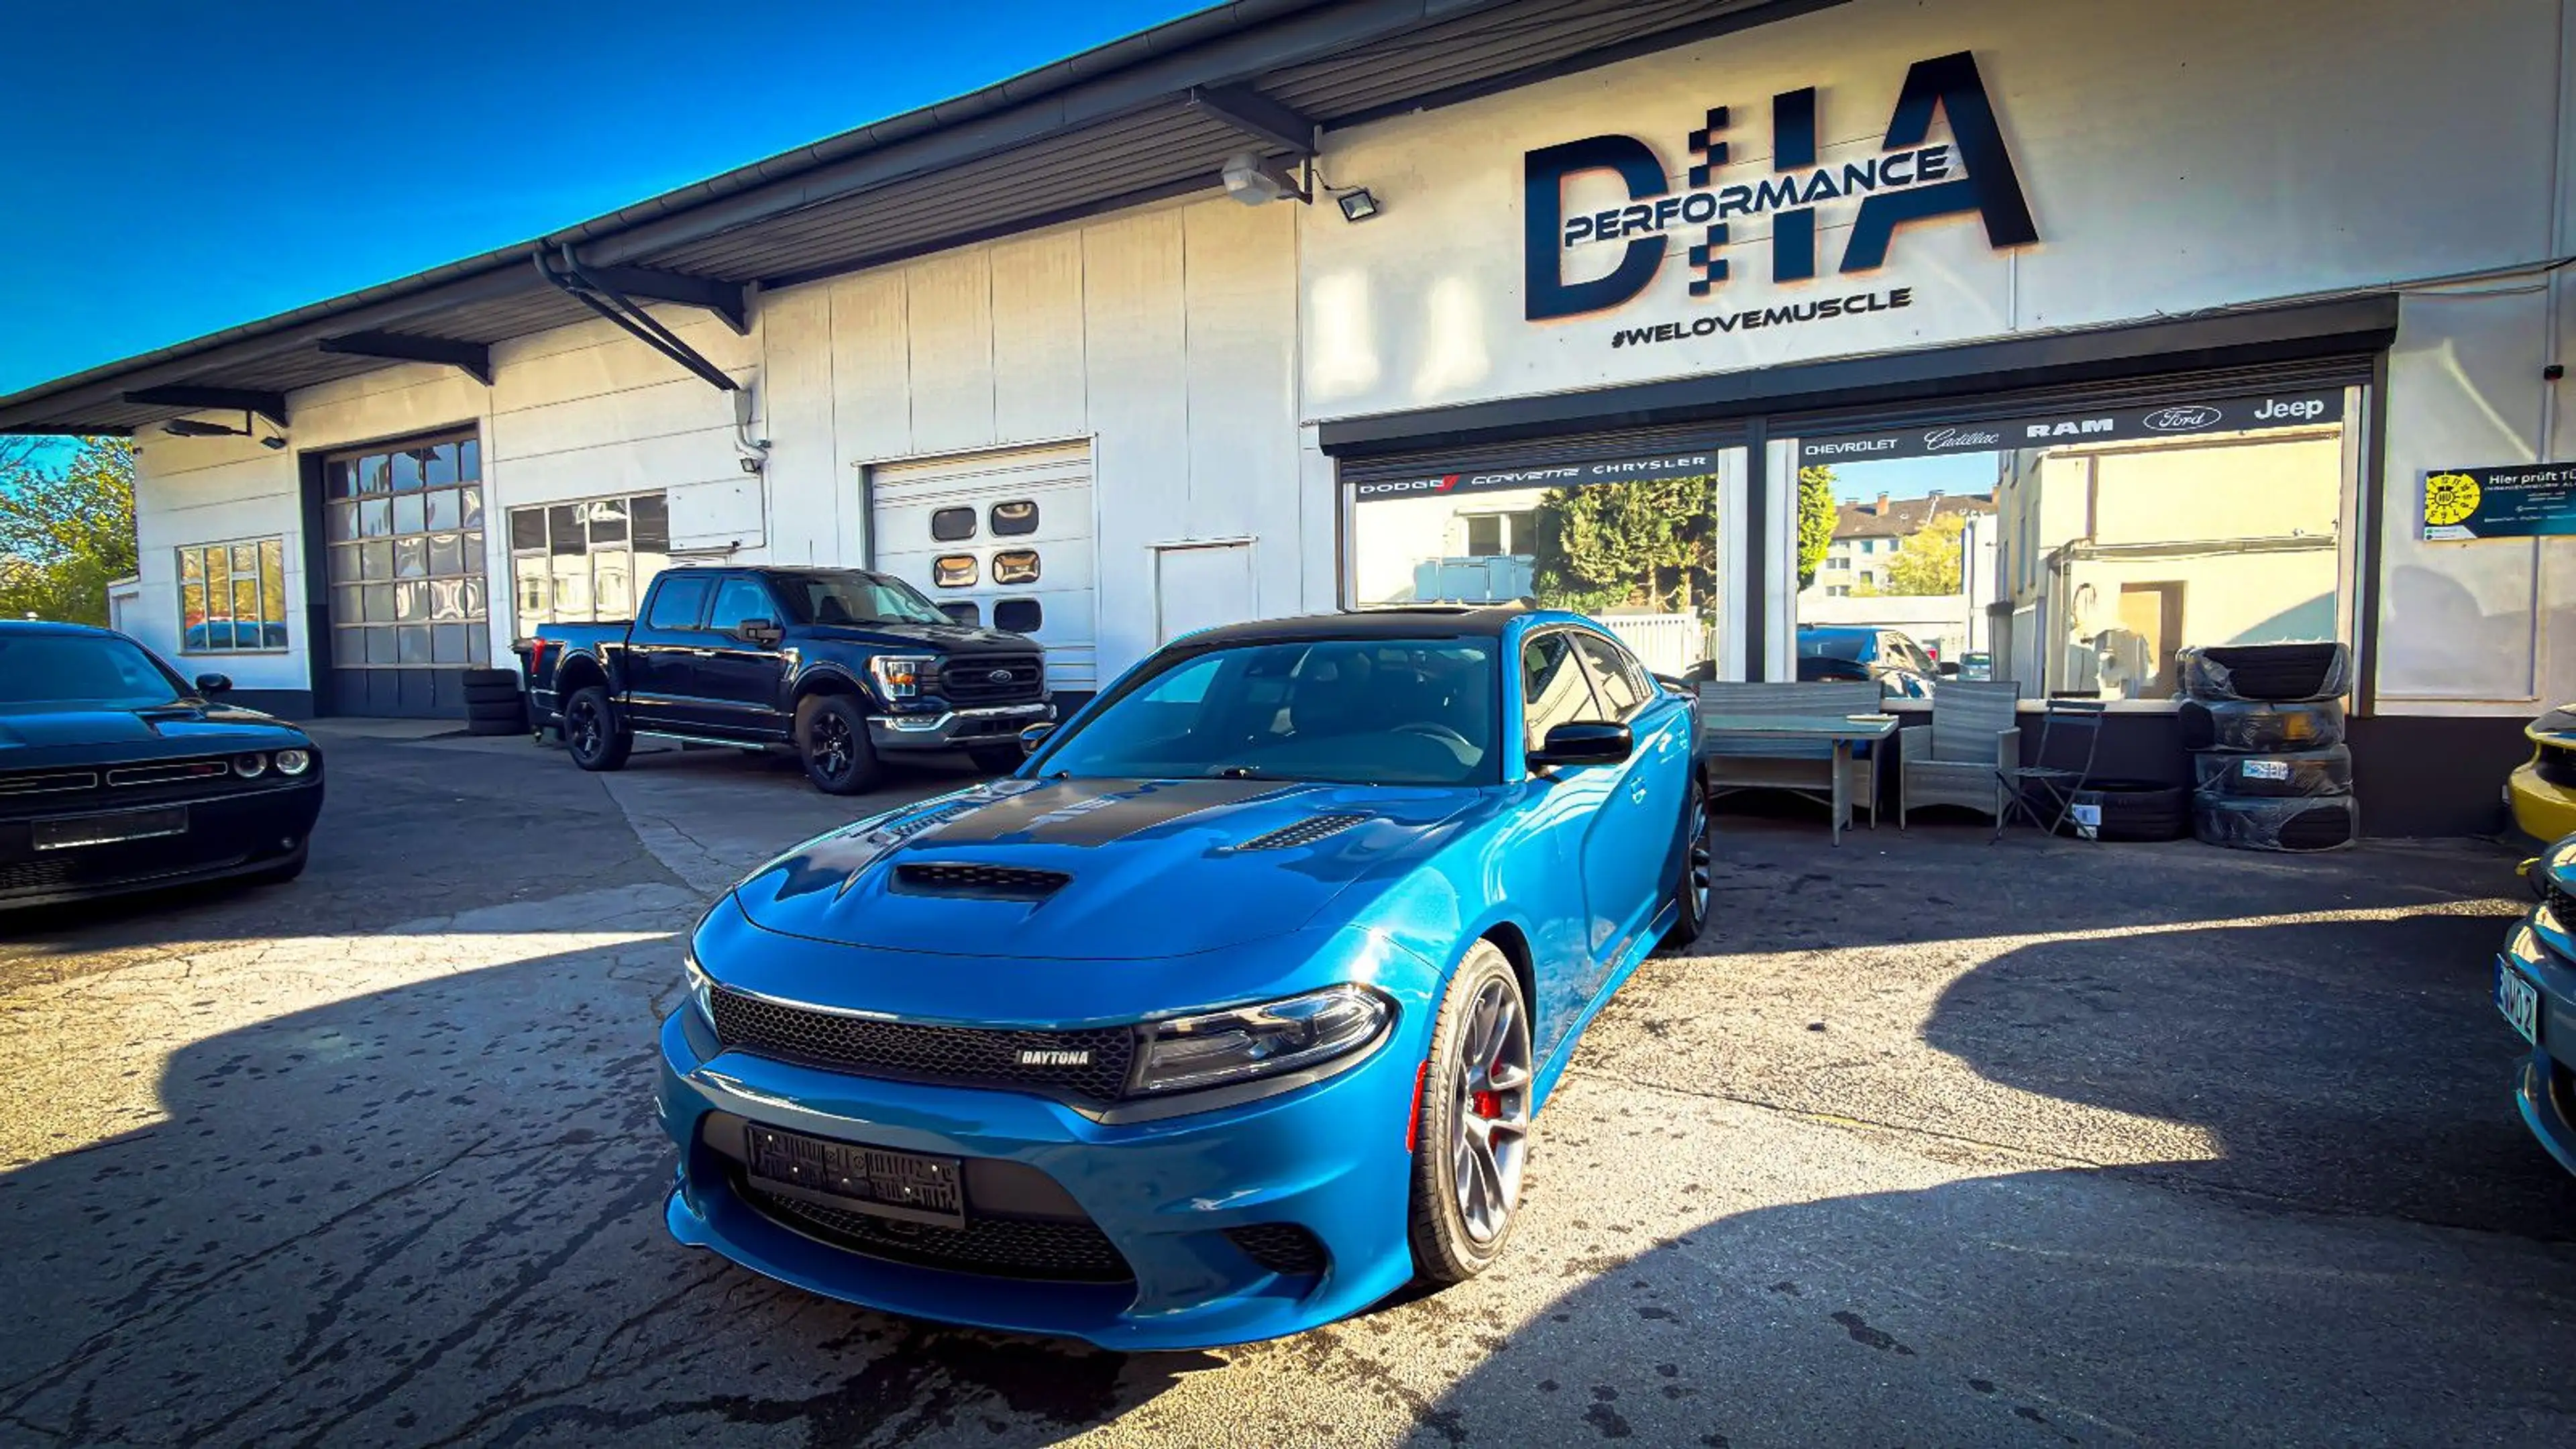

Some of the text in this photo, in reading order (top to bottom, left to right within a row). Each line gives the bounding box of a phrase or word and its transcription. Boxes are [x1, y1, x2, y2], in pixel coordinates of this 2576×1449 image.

[1564, 144, 1949, 248] PERFORMANCE
[1611, 286, 1913, 348] #WELOVEMUSCLE
[1805, 399, 2325, 455] CHEVROLET Cadillac RAM Ford Jeep
[1360, 455, 1707, 494] DODGE CORVETTE CHRYSLER
[2489, 475, 2518, 484] Hier
[2521, 472, 2558, 485] prüft
[1022, 1051, 1088, 1065] DAYTONA
